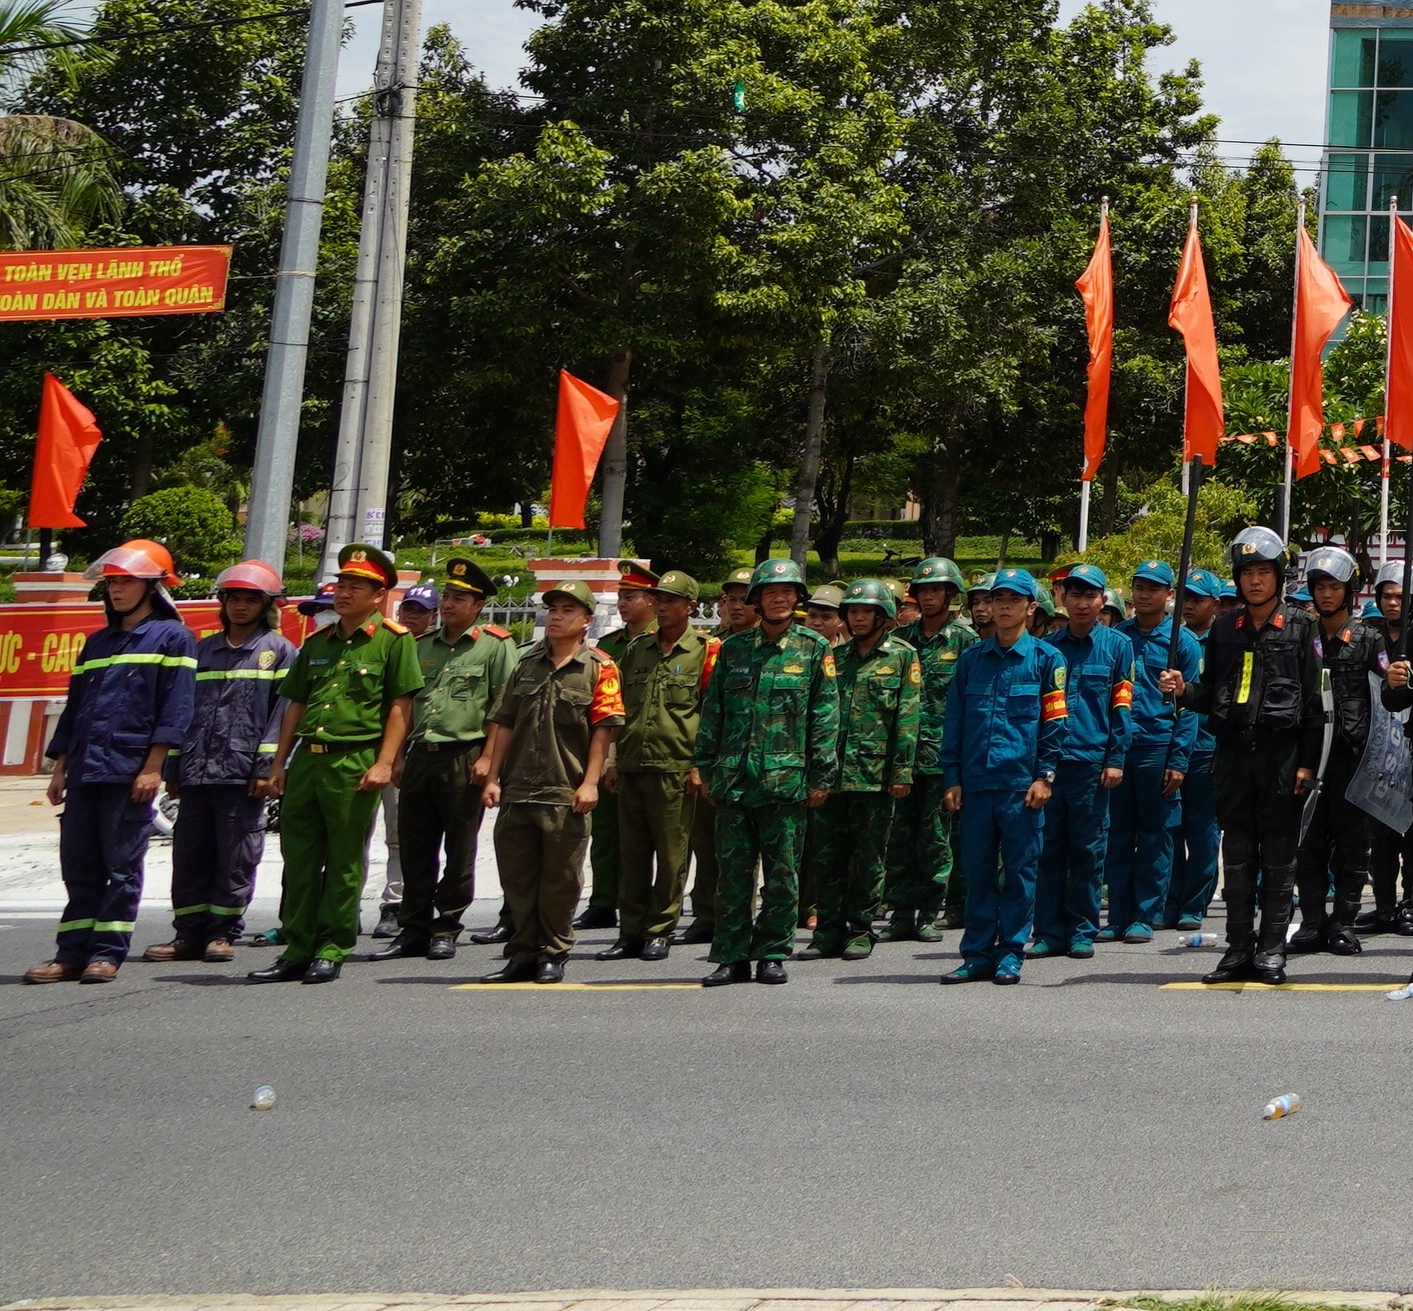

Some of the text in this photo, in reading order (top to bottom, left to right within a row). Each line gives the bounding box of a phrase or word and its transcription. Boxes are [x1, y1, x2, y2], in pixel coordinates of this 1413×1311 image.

[5, 253, 185, 283] TOÀN VẸN LÃNH THỔ
[0, 284, 214, 311] OÀN DÂN VÀ TOÀN QUÂN
[410, 587, 432, 598] 114
